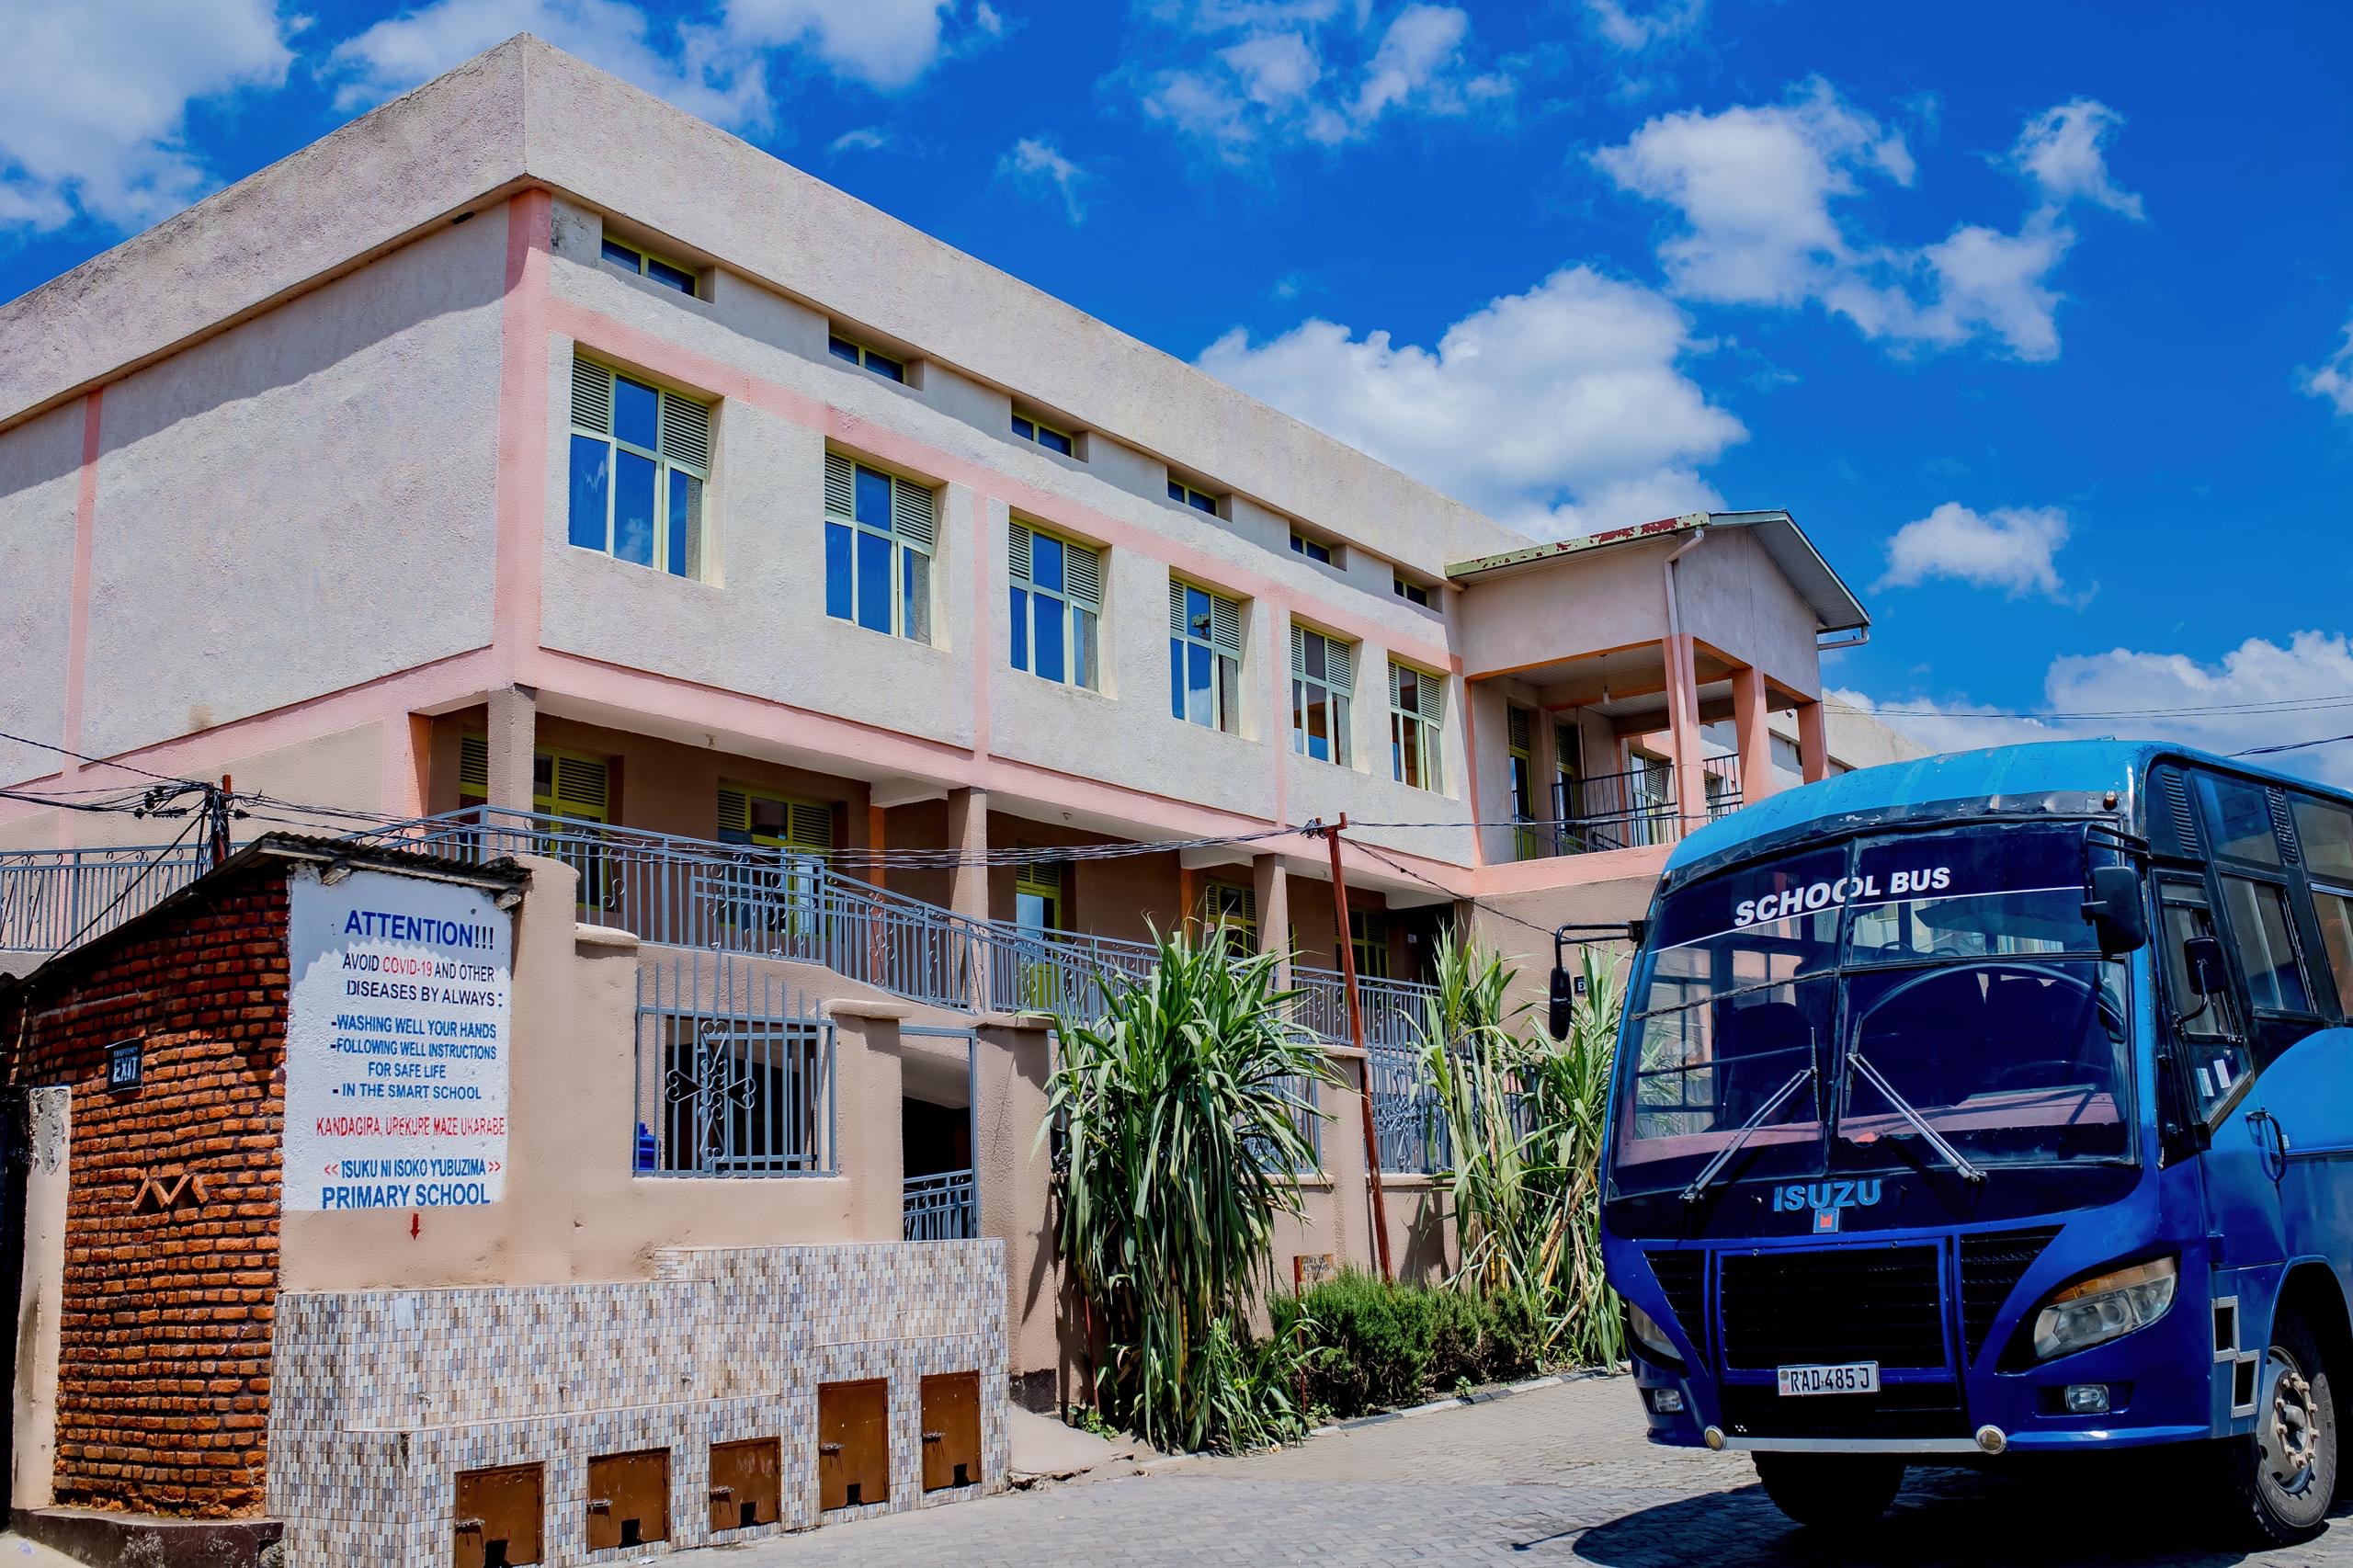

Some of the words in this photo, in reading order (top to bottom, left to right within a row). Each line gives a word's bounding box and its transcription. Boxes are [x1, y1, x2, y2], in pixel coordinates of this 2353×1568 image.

[1733, 875, 1881, 927] SCHOOL
[1890, 867, 1950, 894] BUS
[344, 910, 494, 950] ATTENTION!!!
[342, 952, 380, 971] AVOID
[382, 956, 432, 977] COVID-19
[435, 961, 457, 979] AND
[460, 964, 494, 983] OTHER
[347, 980, 416, 1001] DISEASES
[421, 986, 439, 1003] BY
[395, 1017, 426, 1035] WELL
[427, 1019, 458, 1037] YOUR
[460, 1022, 497, 1039] HANDS
[400, 1041, 426, 1057] WELL
[428, 1043, 497, 1060] INSTRUCTIONS
[112, 1056, 139, 1083] EXIT
[368, 1062, 392, 1077] FOR
[394, 1062, 421, 1078] SAFE
[425, 1064, 447, 1079] LIFE
[342, 1083, 356, 1097] IN
[359, 1083, 384, 1097] THE
[388, 1085, 429, 1099] SMART
[433, 1085, 482, 1100] SCHOOL
[316, 1117, 383, 1138] KANDAGIRA,
[433, 1117, 459, 1136] MAZE
[460, 1117, 506, 1136] UKARABE
[381, 1160, 392, 1177] NI
[394, 1159, 427, 1177] ISOKO
[322, 1184, 411, 1210] PRIMARY
[415, 1183, 491, 1206] SCHOOL
[1773, 1178, 1882, 1211] ISUZU
